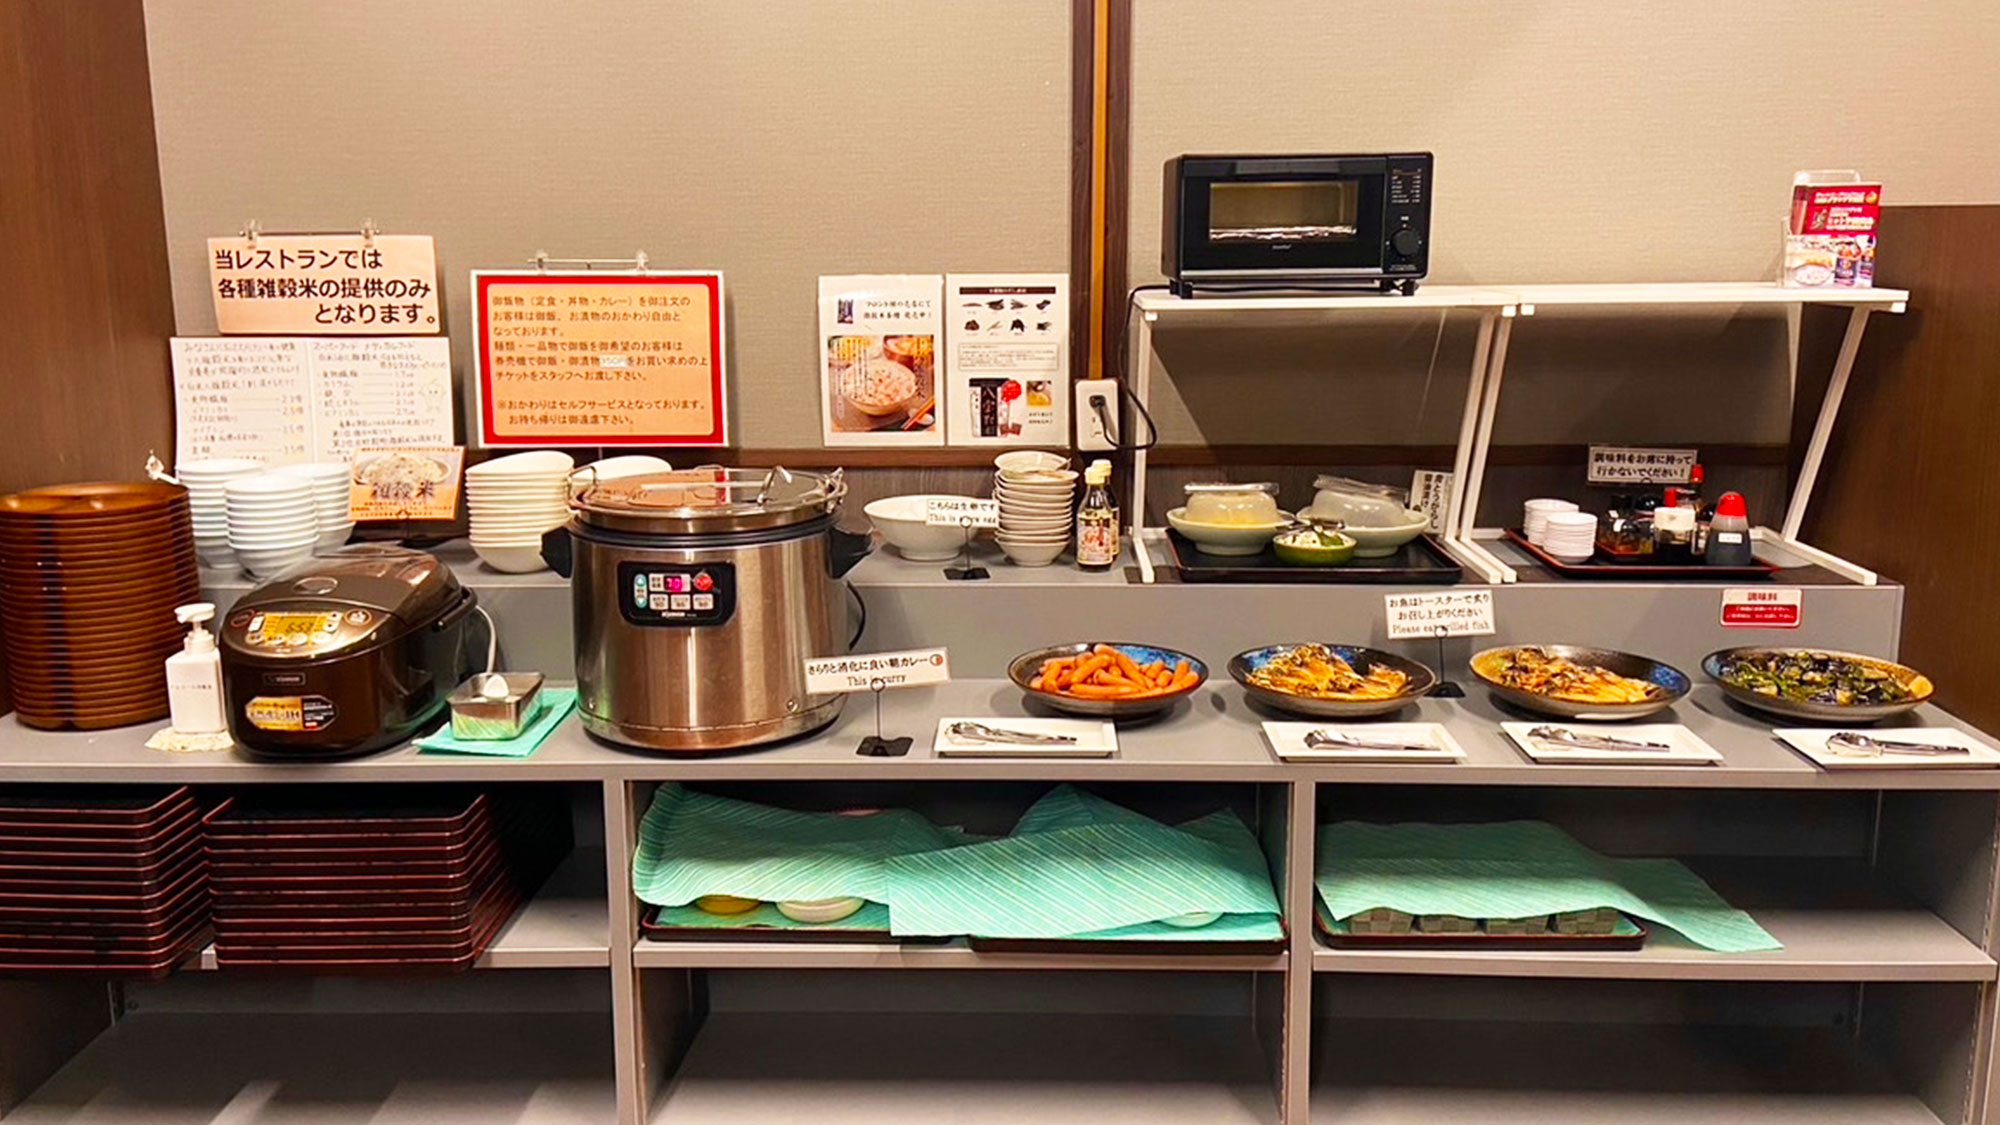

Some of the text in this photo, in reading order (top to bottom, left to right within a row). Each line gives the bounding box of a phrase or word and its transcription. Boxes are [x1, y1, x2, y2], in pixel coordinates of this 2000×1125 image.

[215, 249, 383, 269] 当レストランでは
[218, 278, 431, 299] 各種雑穀米の提供のみ
[314, 303, 436, 324] となります。
[493, 326, 565, 337] なっております。
[1596, 466, 1685, 478] 行かないでください！
[1397, 607, 1484, 621] お召し上がりください
[1392, 624, 1420, 634] Please
[847, 676, 867, 687] This
